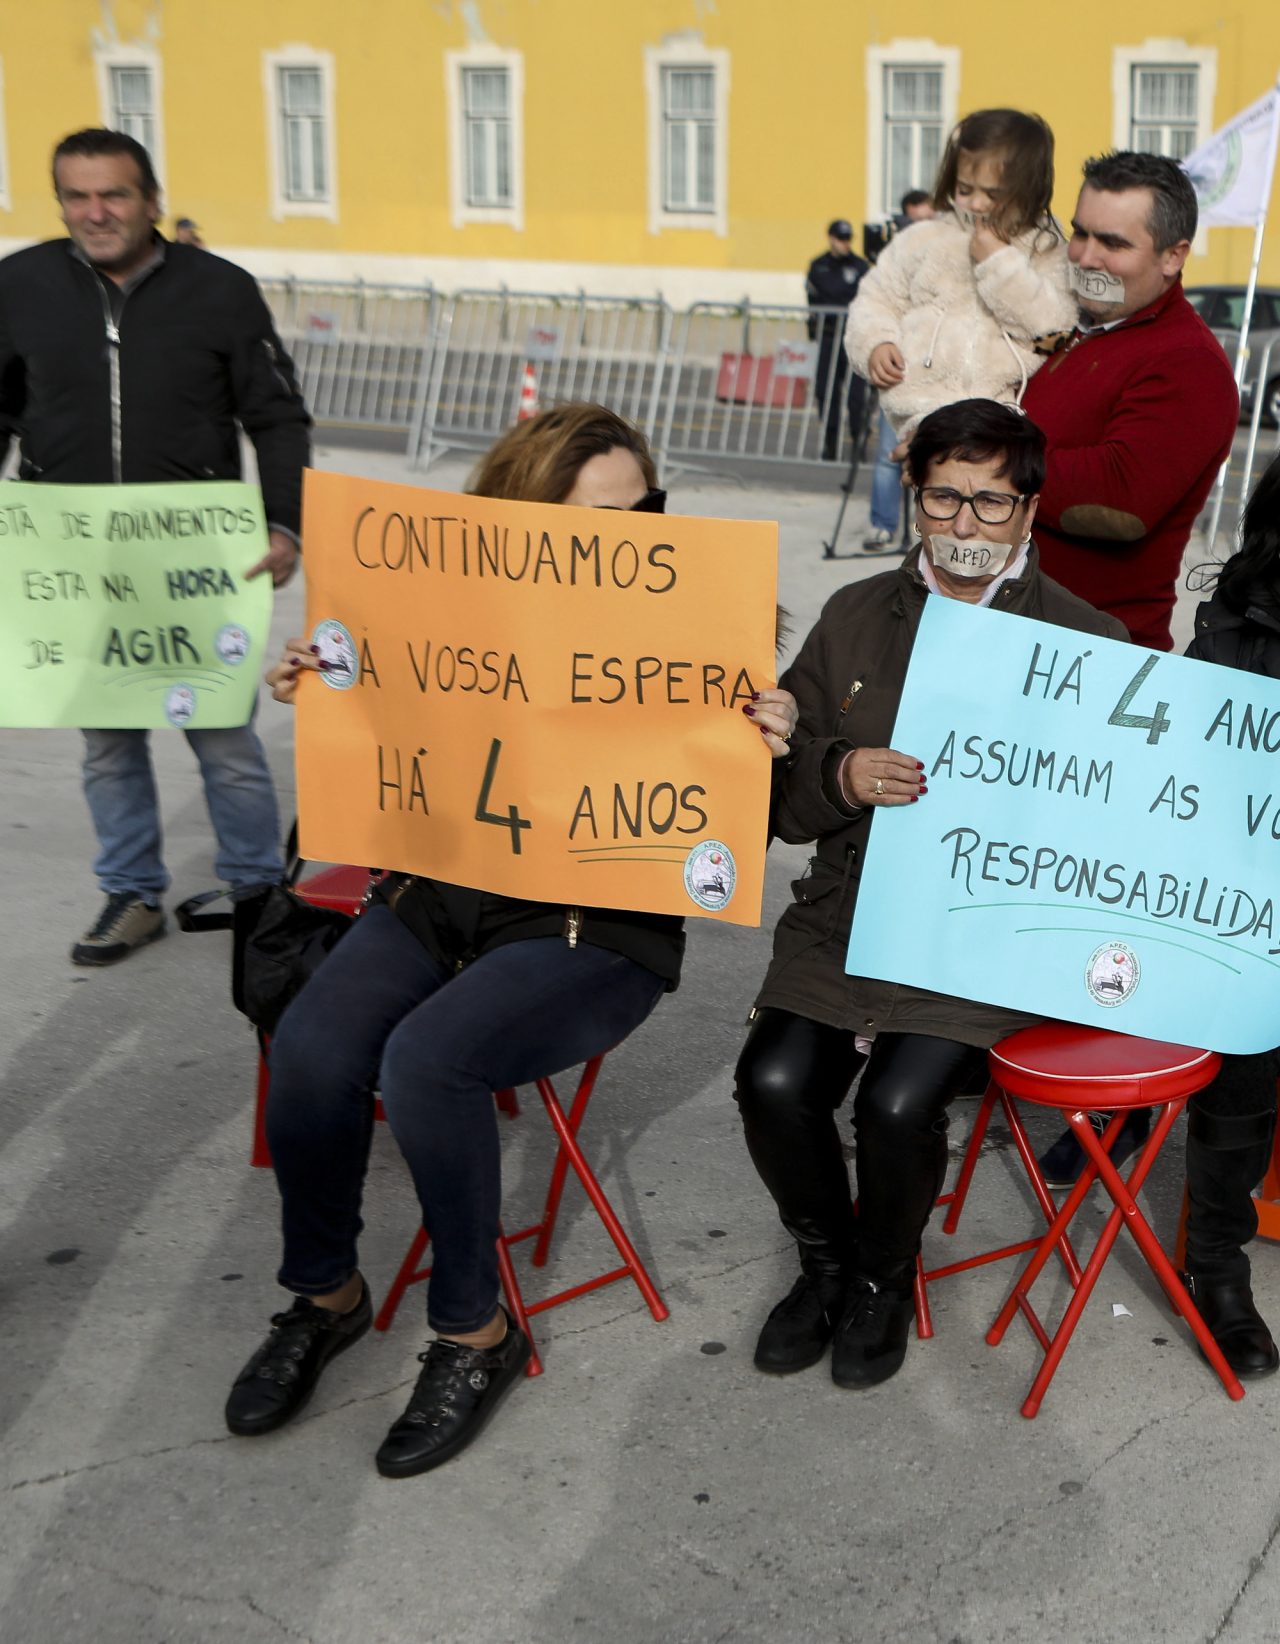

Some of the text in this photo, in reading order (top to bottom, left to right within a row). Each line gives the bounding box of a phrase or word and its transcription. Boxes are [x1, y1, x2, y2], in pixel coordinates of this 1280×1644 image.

[61, 510, 94, 540] DE
[24, 567, 238, 602] ESTA NA HORA
[26, 640, 64, 669] DE
[406, 640, 529, 702] VOSSA
[572, 653, 757, 708] ESPERA
[1022, 642, 1093, 705] HÁ
[1107, 654, 1171, 745] 4
[378, 737, 708, 855] HÁ 4 ANOS
[930, 730, 1113, 803] ASSUMAM
[1149, 775, 1200, 820] AS
